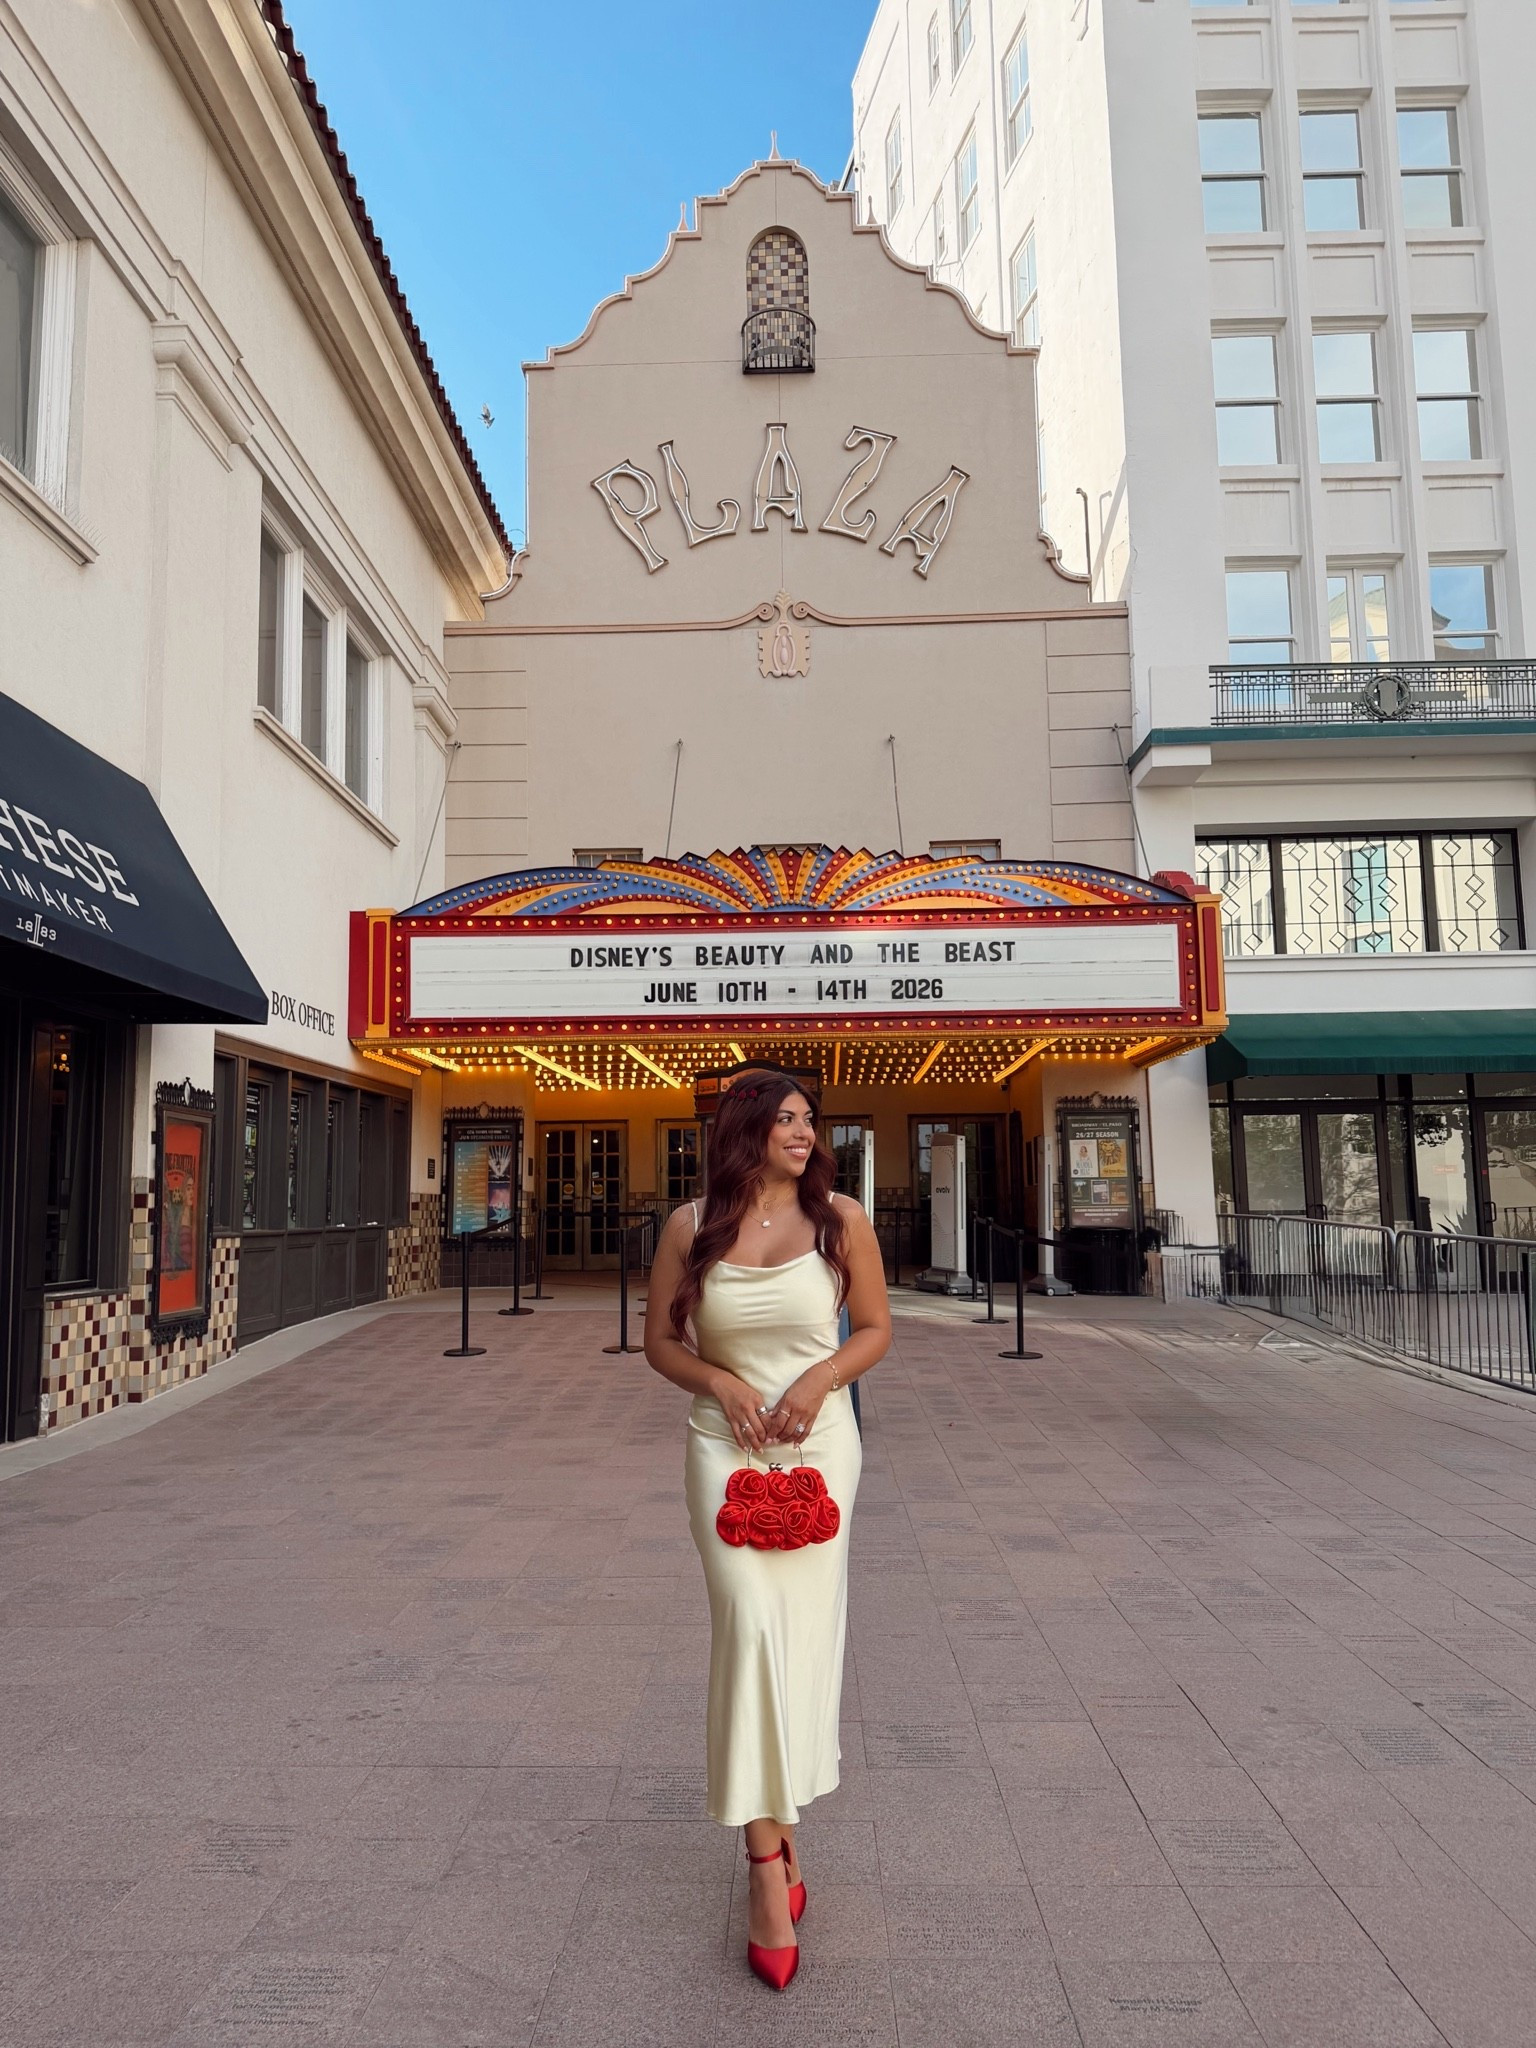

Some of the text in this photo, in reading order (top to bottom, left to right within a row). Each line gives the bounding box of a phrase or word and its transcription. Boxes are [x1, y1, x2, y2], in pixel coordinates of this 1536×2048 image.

[590, 422, 971, 580] PLAZA
[570, 941, 1015, 968] DISNEY'S BEAUTY AND THE BEAST
[644, 982, 697, 1003] JUNE
[718, 981, 767, 1002] 10TH
[817, 979, 867, 1000] 14TH
[891, 978, 943, 999] 2026
[271, 990, 335, 1036] BOX OFFICE
